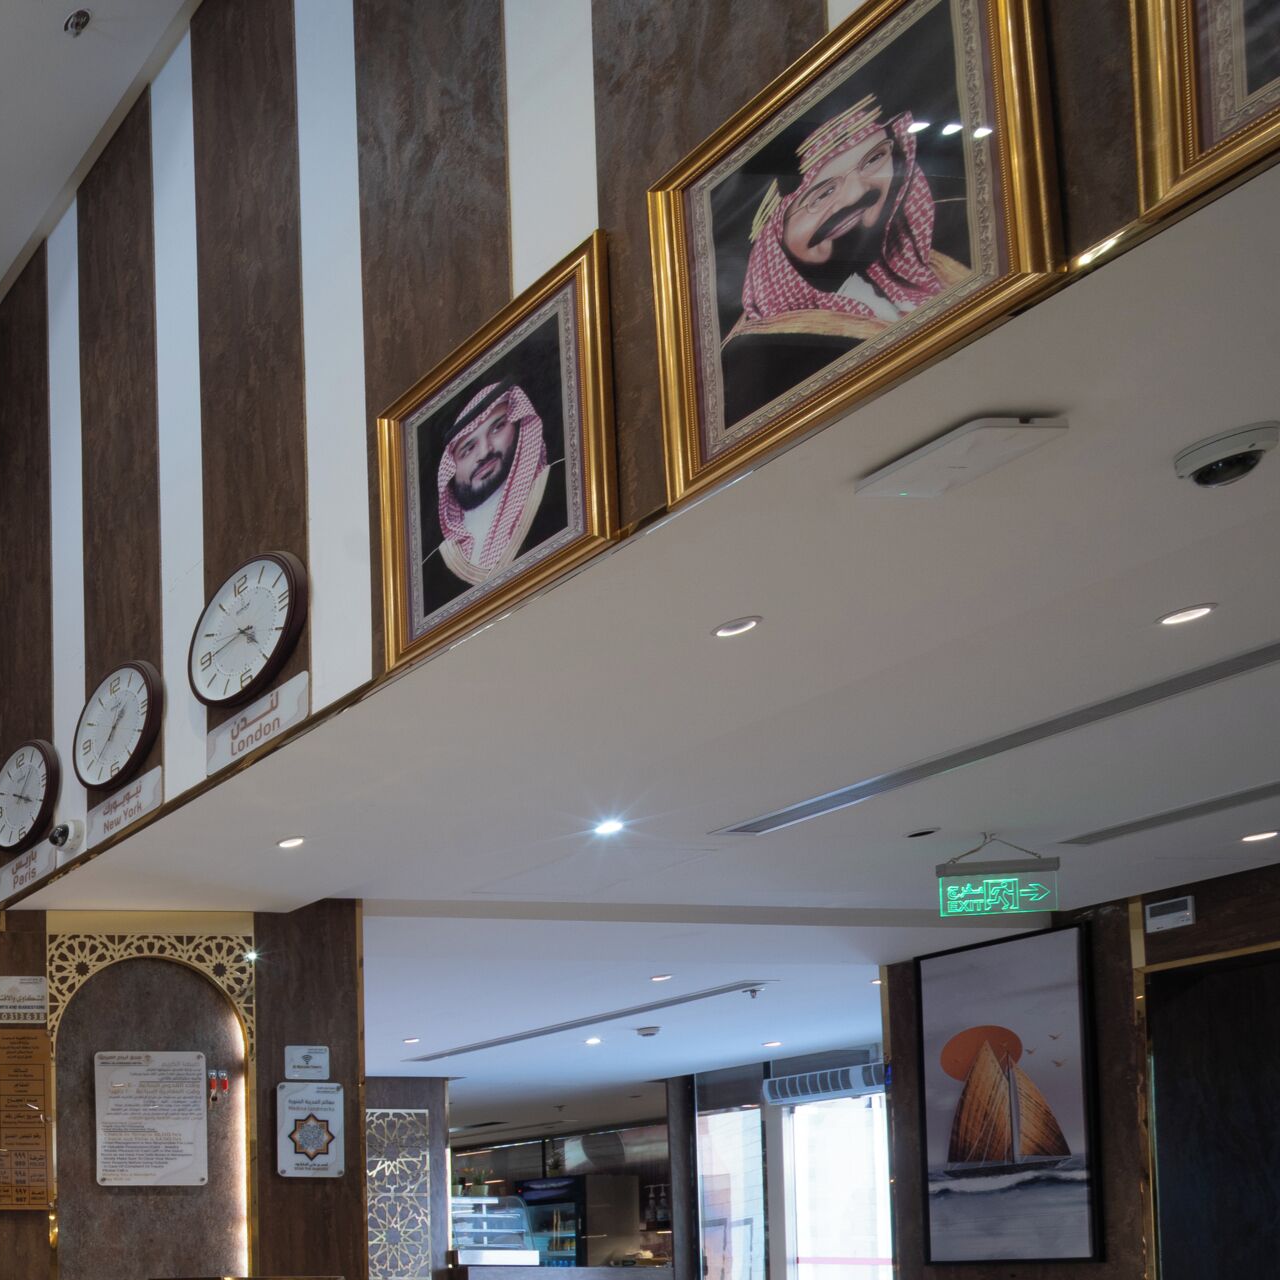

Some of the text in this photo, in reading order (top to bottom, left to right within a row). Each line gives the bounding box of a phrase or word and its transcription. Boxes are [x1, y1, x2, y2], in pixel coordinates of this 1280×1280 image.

[230, 716, 280, 757] London
[103, 801, 143, 835] New York
[12, 865, 37, 890] Paris
[947, 899, 984, 913] EXIT
